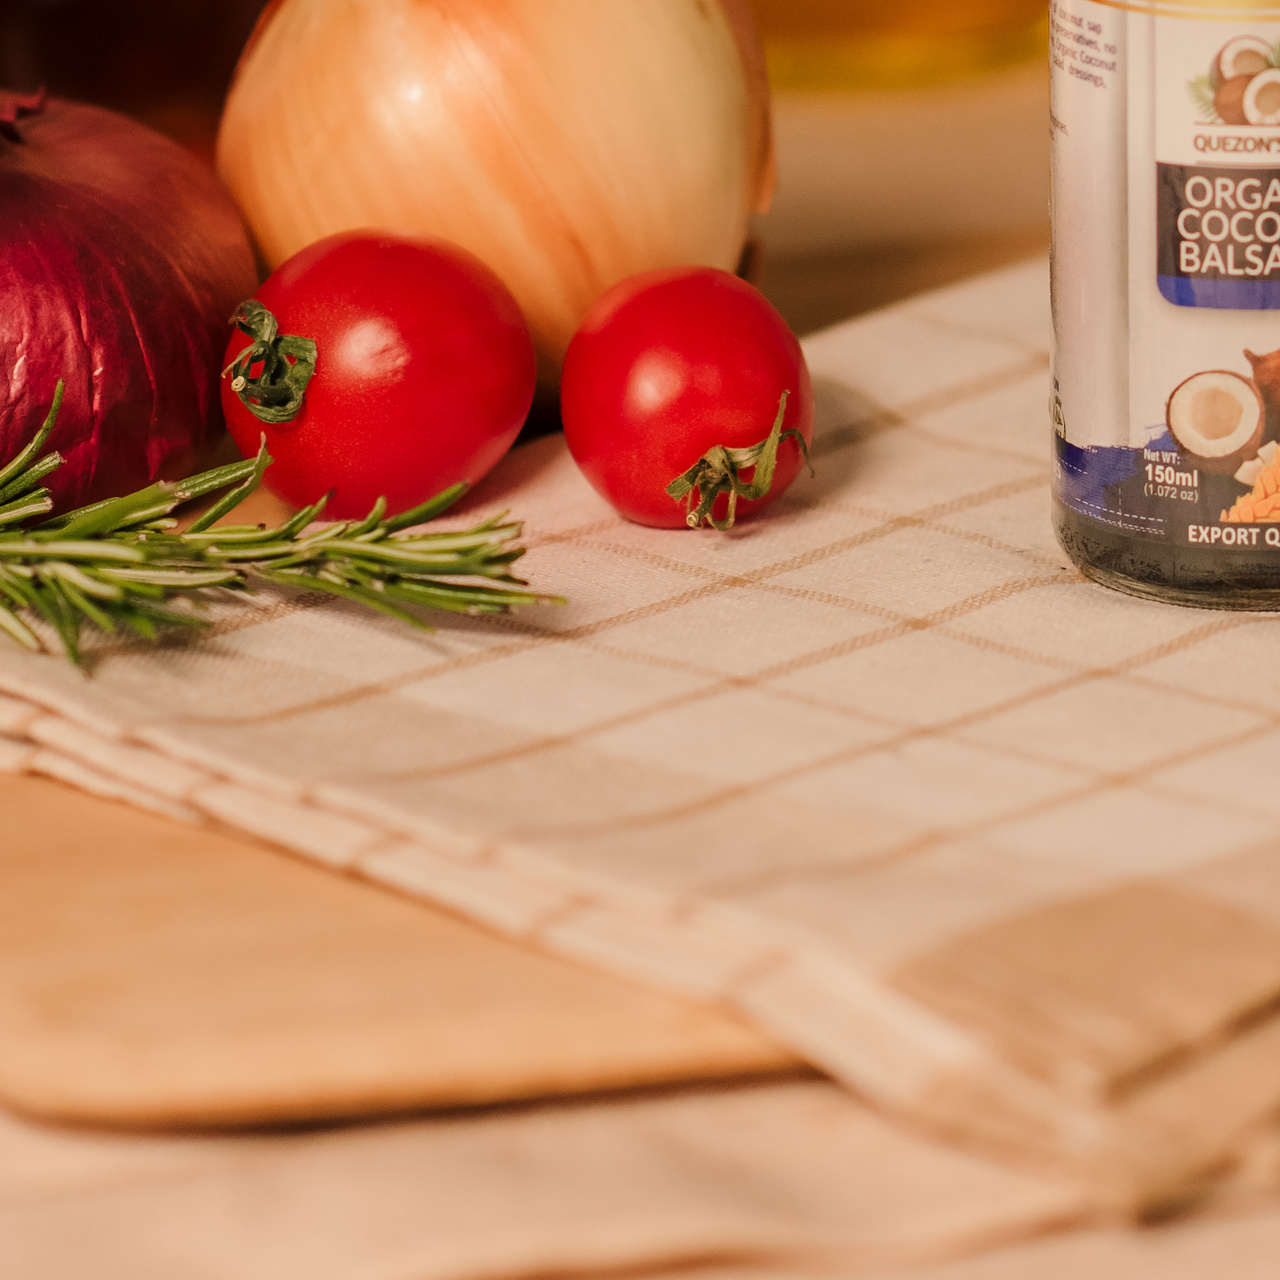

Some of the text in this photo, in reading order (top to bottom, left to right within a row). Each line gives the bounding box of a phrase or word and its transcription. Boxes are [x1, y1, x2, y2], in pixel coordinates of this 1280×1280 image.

[1080, 50, 1117, 71] Coconut
[1143, 448, 1181, 465] Net WT:
[1145, 463, 1199, 487] 150ml
[1143, 482, 1199, 504] (1.072 oz)
[1187, 524, 1260, 545] EXPORT
